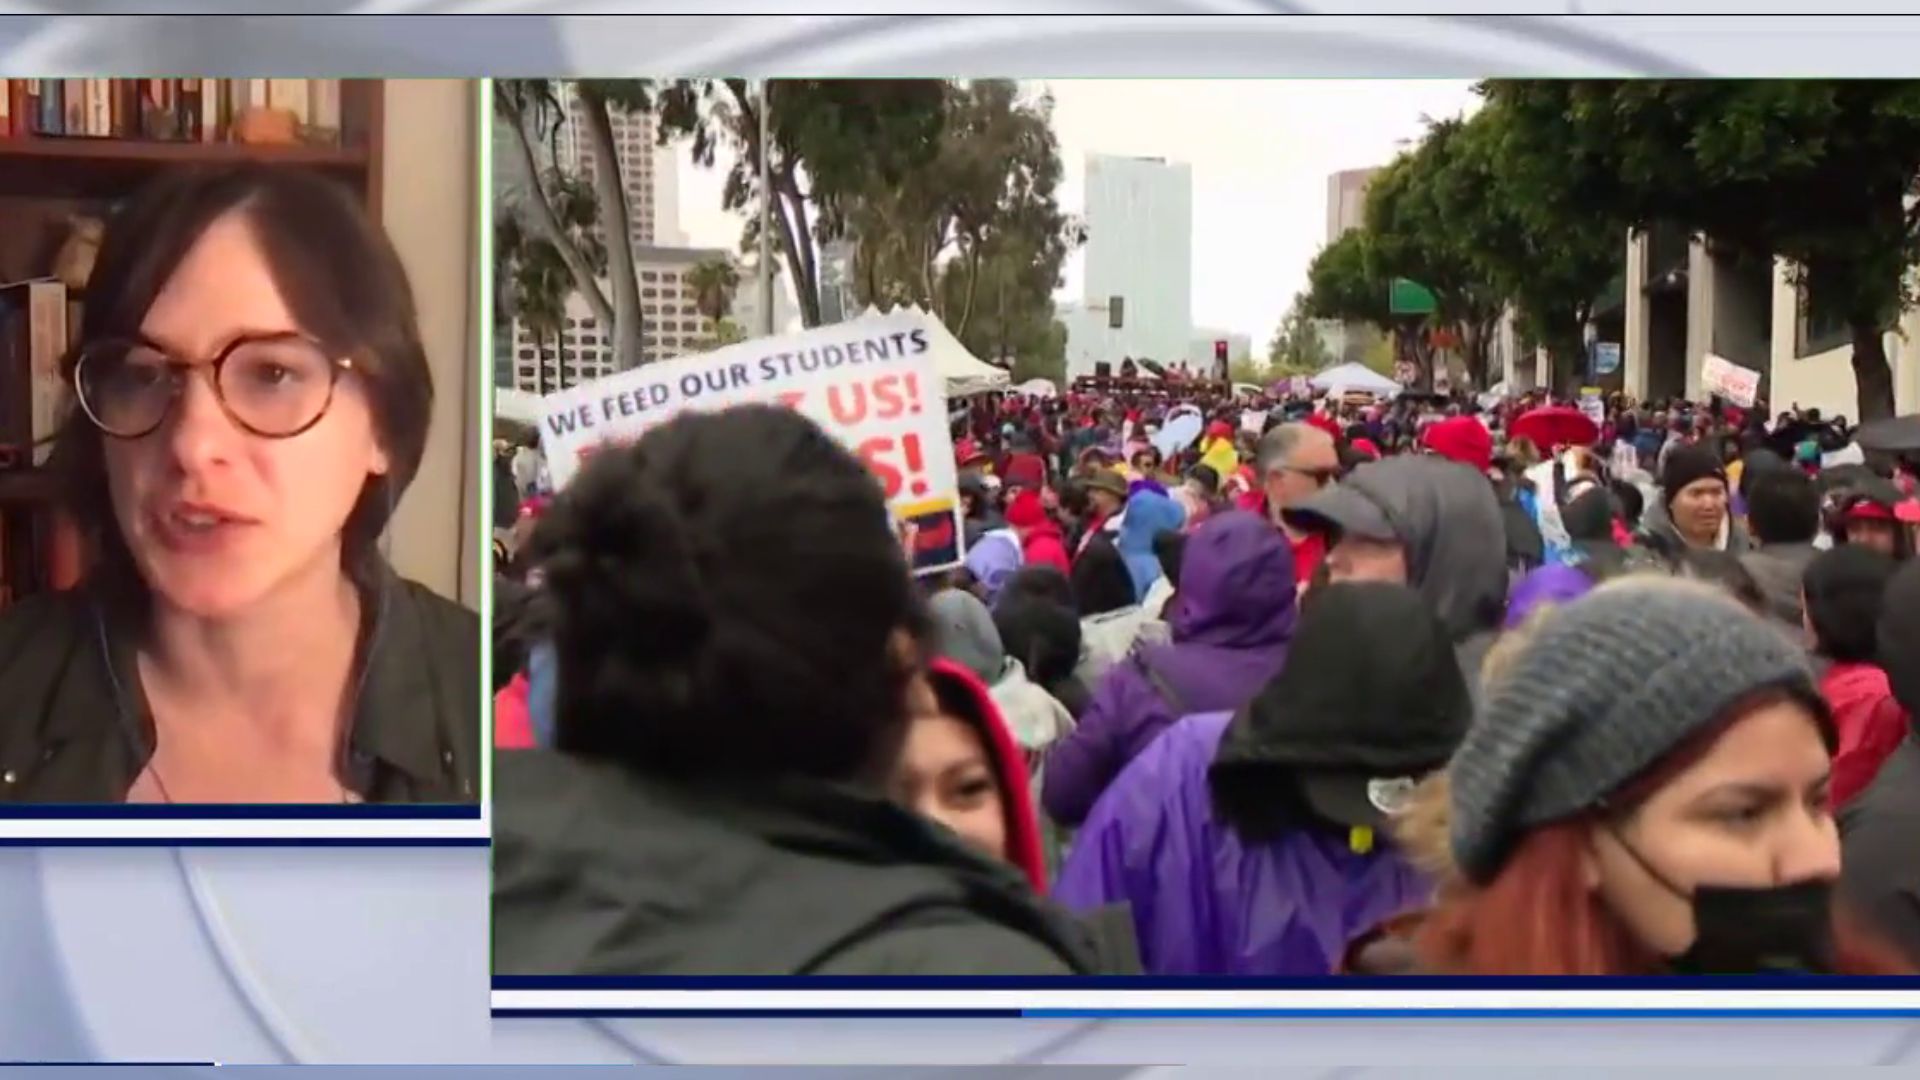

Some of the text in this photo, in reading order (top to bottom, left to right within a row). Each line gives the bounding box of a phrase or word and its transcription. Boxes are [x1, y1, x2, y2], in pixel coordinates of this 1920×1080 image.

[547, 404, 595, 436] WE
[601, 383, 670, 421] FEED
[680, 363, 750, 397] OUR
[759, 329, 929, 380] STUDENTS
[827, 370, 923, 426] US!
